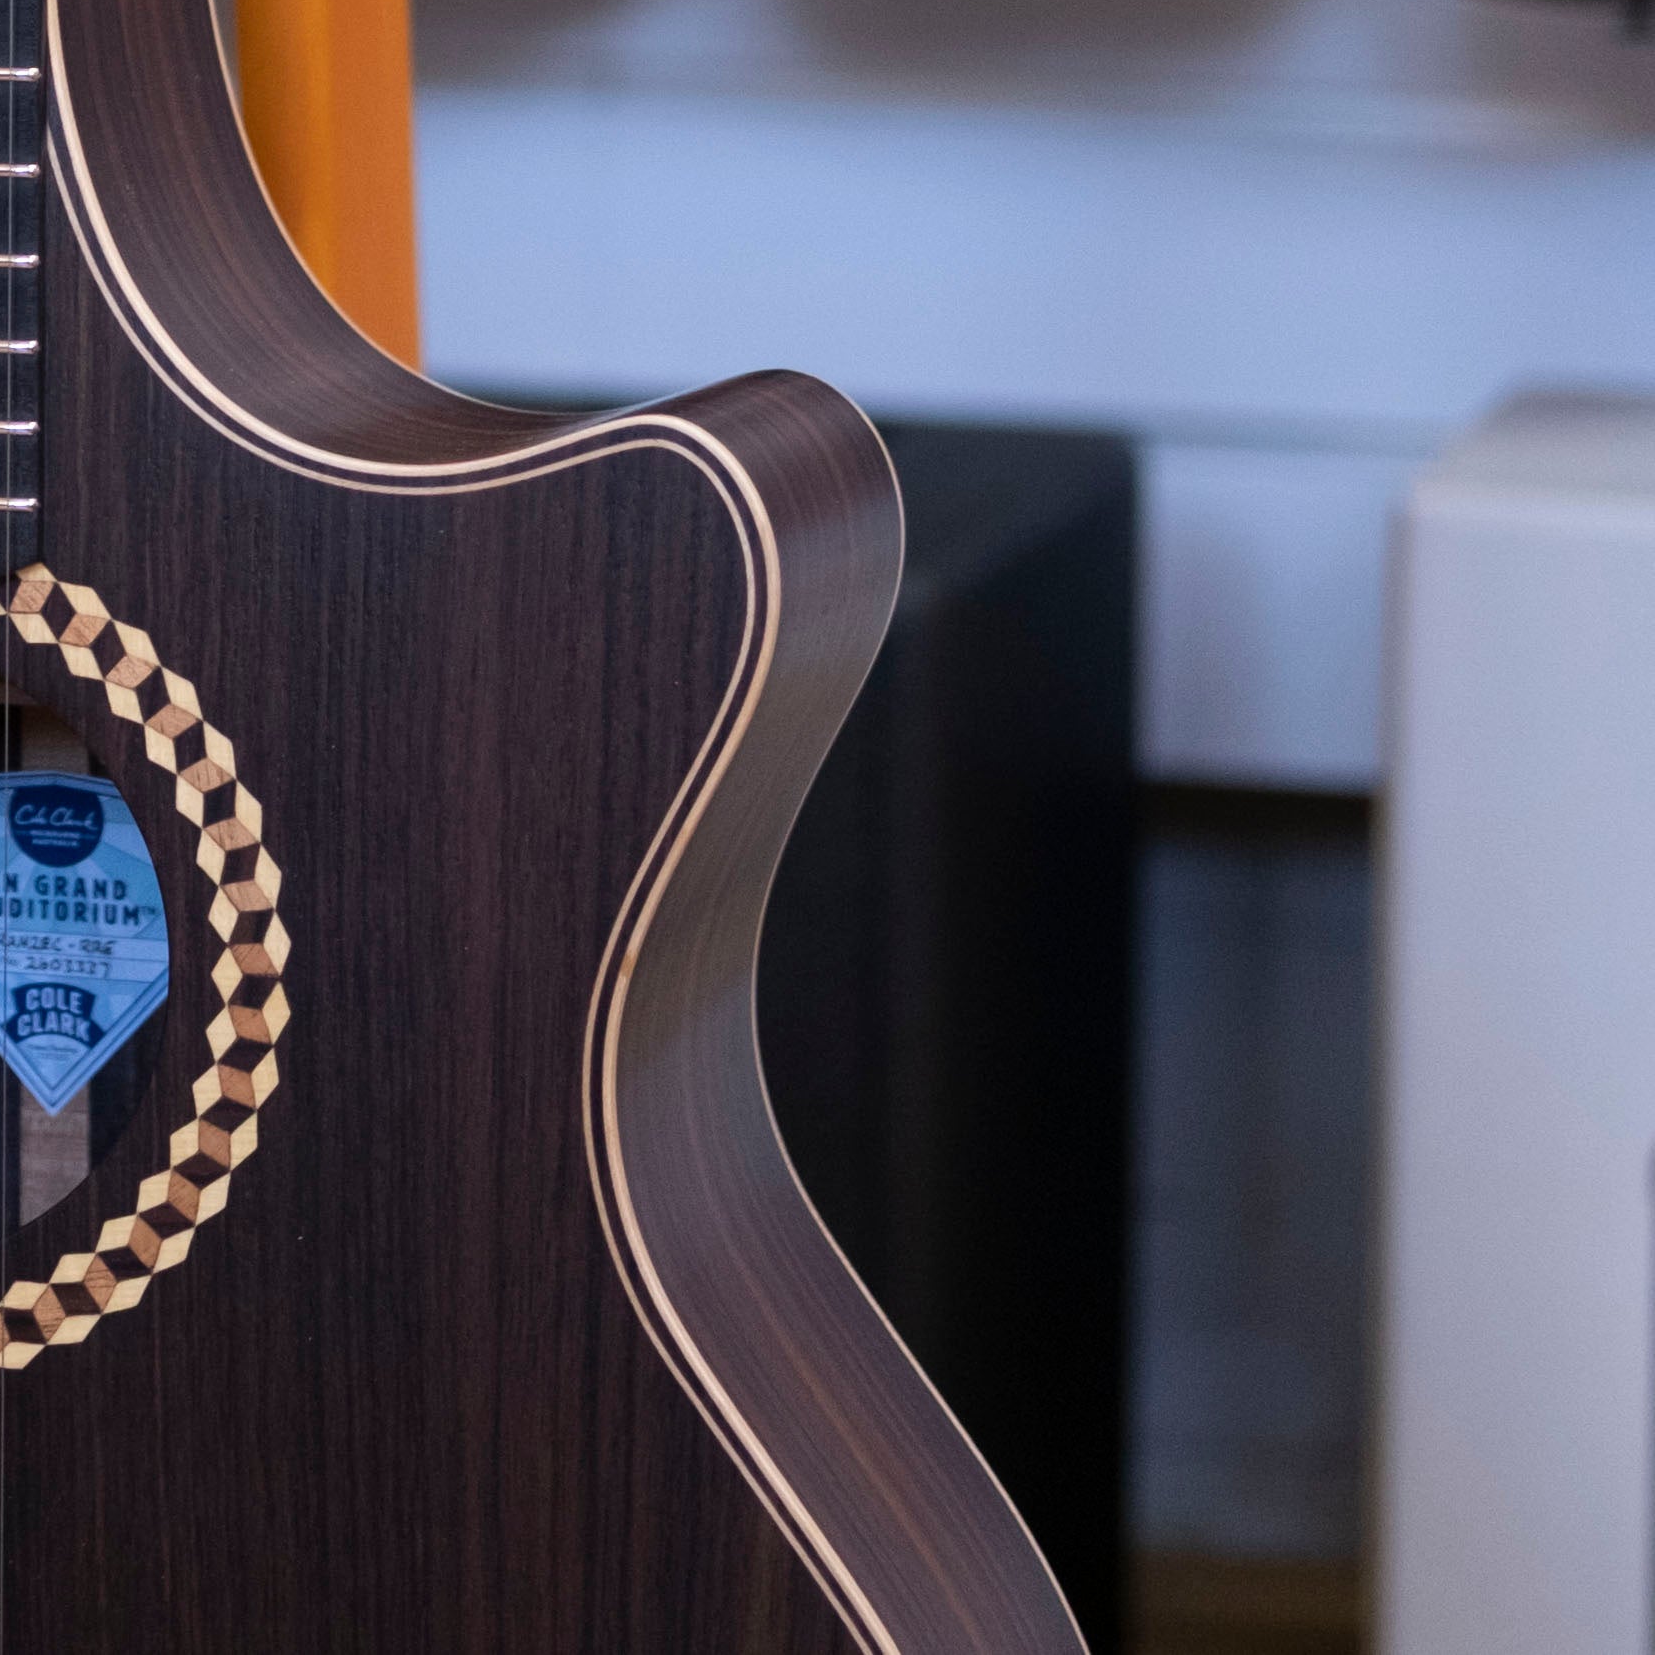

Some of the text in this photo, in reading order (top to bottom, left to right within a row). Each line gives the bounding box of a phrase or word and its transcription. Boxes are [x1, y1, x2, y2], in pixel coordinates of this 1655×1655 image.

[34, 874, 128, 901] GRAND
[26, 987, 83, 1015] COLE
[16, 1010, 91, 1043] CLARK
